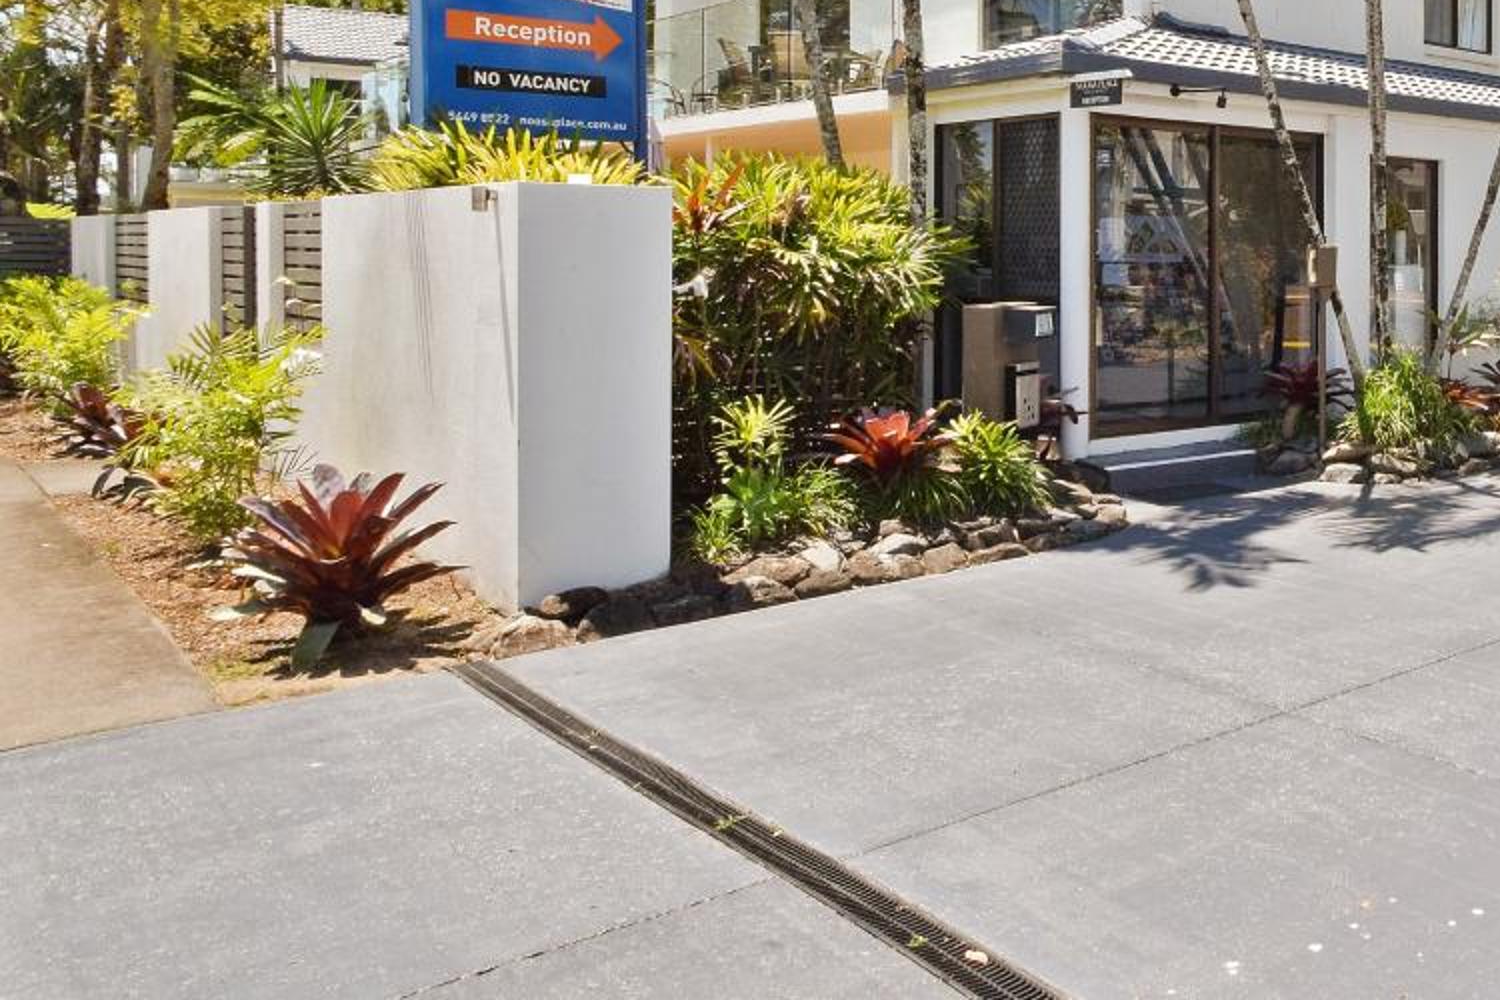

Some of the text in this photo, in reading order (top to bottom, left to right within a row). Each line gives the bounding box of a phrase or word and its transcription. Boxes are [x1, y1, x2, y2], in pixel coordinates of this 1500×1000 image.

[474, 16, 592, 46] Reception
[473, 70, 591, 93] NO VACANCY
